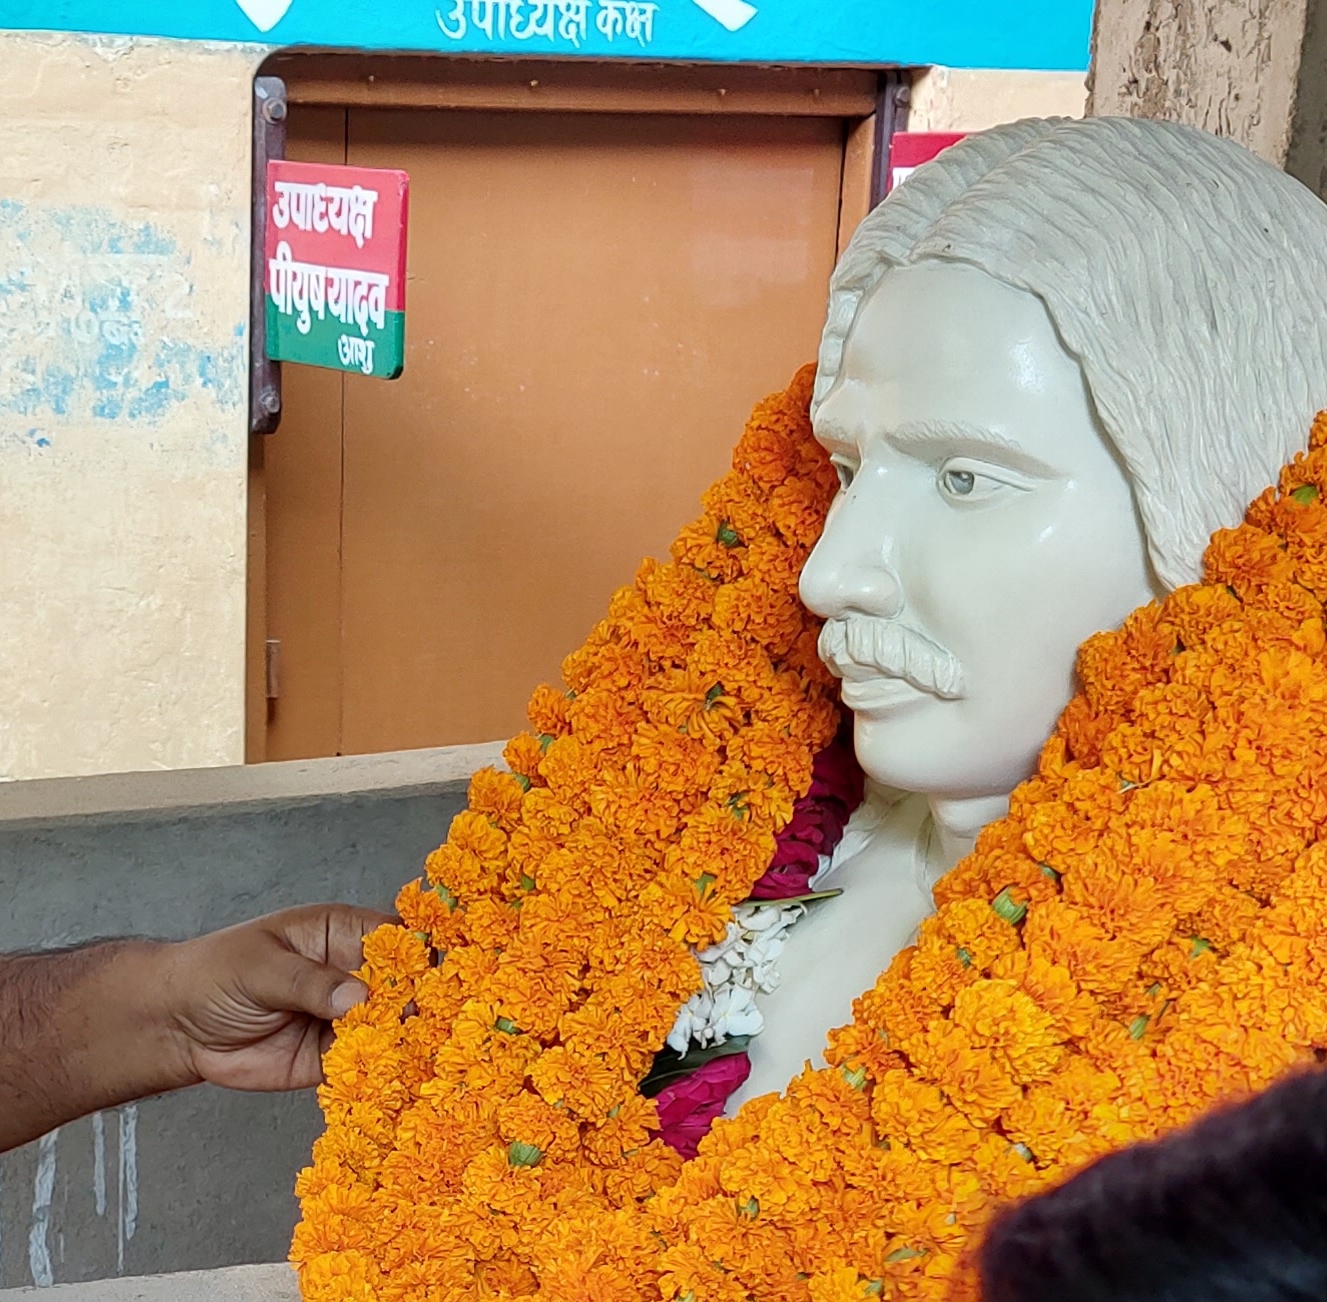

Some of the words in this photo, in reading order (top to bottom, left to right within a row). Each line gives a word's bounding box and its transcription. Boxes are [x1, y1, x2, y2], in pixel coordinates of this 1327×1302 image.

[435, 0, 593, 48] उपाध्यक्ष
[595, 0, 660, 48] कक्ष
[273, 181, 378, 249] उपाध्यक्ष
[325, 269, 390, 336] यादव
[338, 334, 376, 375] आशु
